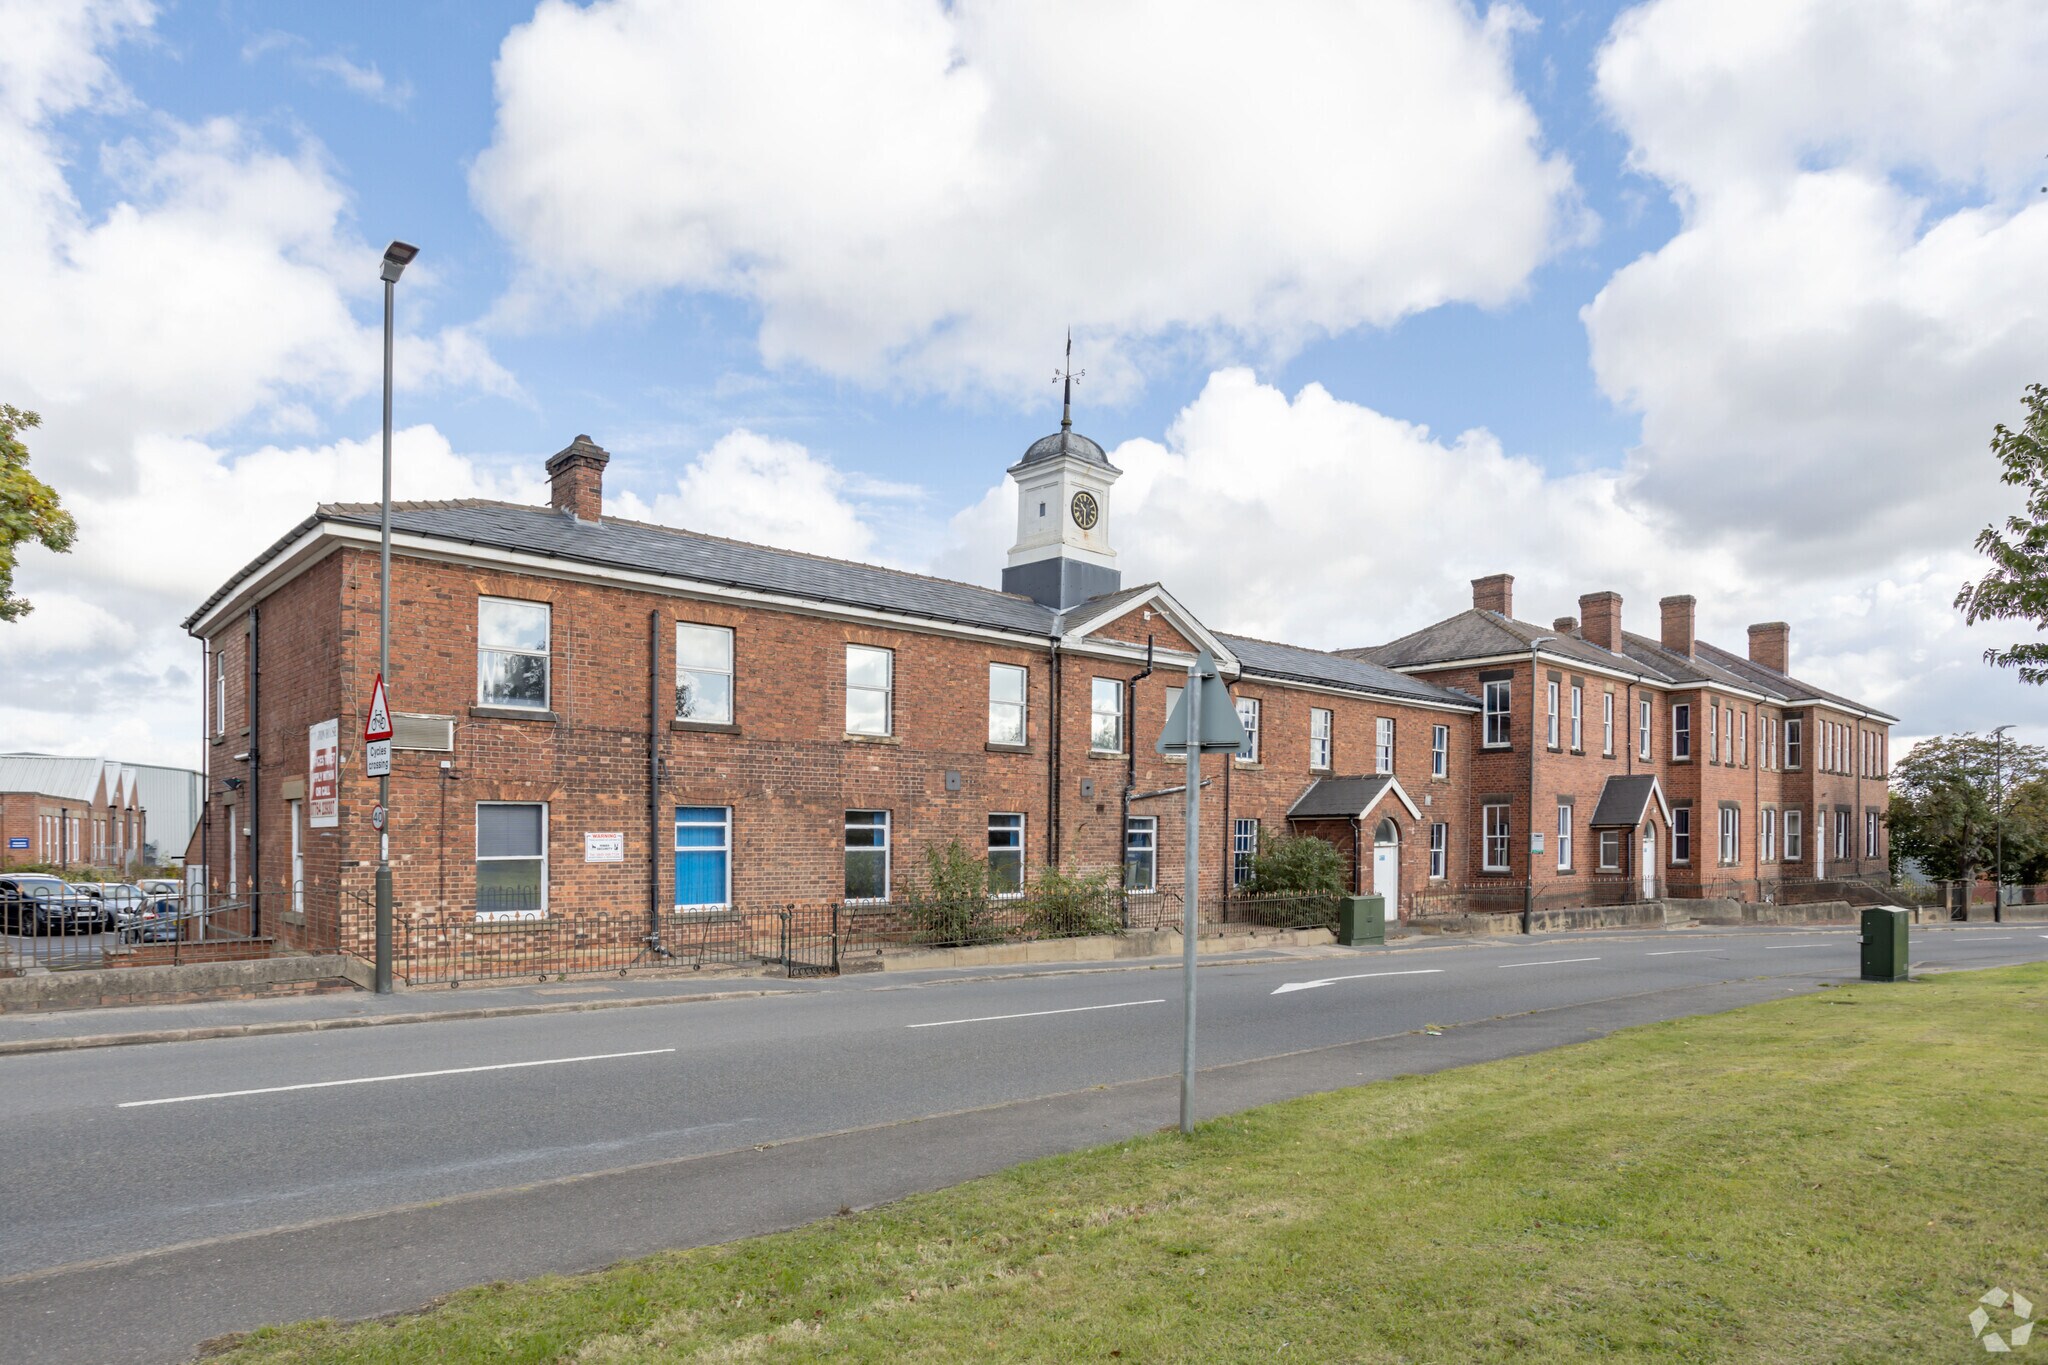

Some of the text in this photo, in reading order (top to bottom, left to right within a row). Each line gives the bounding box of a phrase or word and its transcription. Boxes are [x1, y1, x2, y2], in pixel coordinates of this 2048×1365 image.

[371, 746, 386, 758] Cycles
[369, 759, 388, 770] crossing
[316, 786, 331, 796] OR CALL
[374, 812, 382, 822] 40
